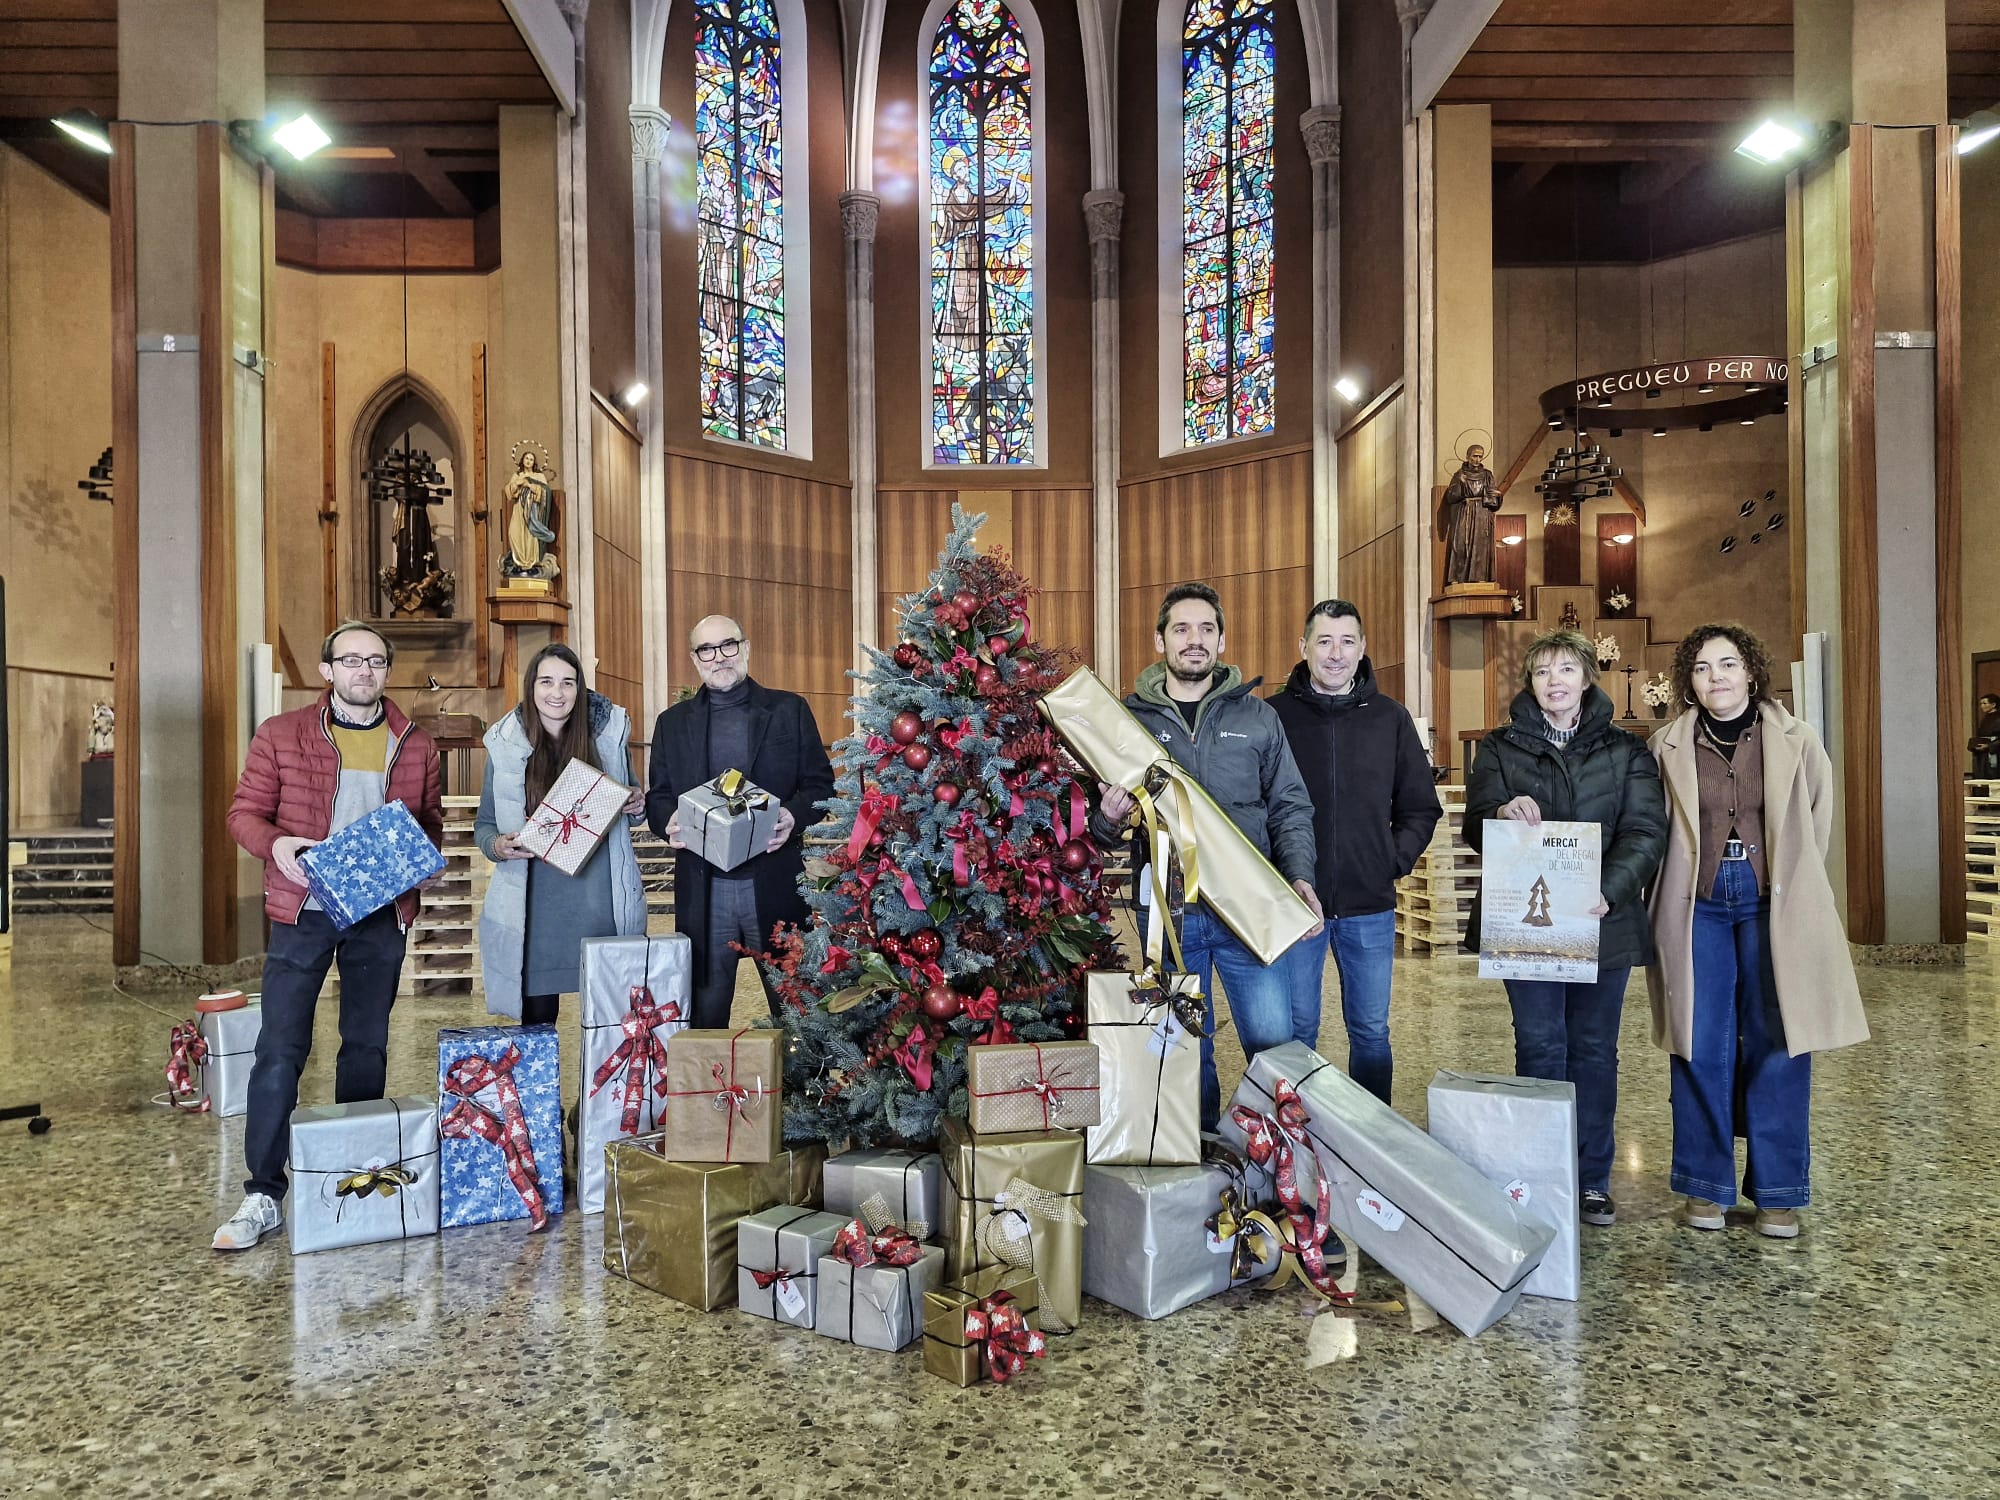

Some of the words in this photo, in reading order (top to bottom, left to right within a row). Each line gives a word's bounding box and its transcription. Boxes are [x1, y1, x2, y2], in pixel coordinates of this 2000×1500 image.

[1576, 365, 1690, 401] PREGUEU
[1707, 361, 1754, 381] PER
[1542, 837, 1579, 848] MERCAT
[1556, 849, 1571, 860] DEL
[1572, 849, 1595, 861] REGAL
[1548, 860, 1559, 871] DE
[1560, 860, 1584, 872] NADAL
